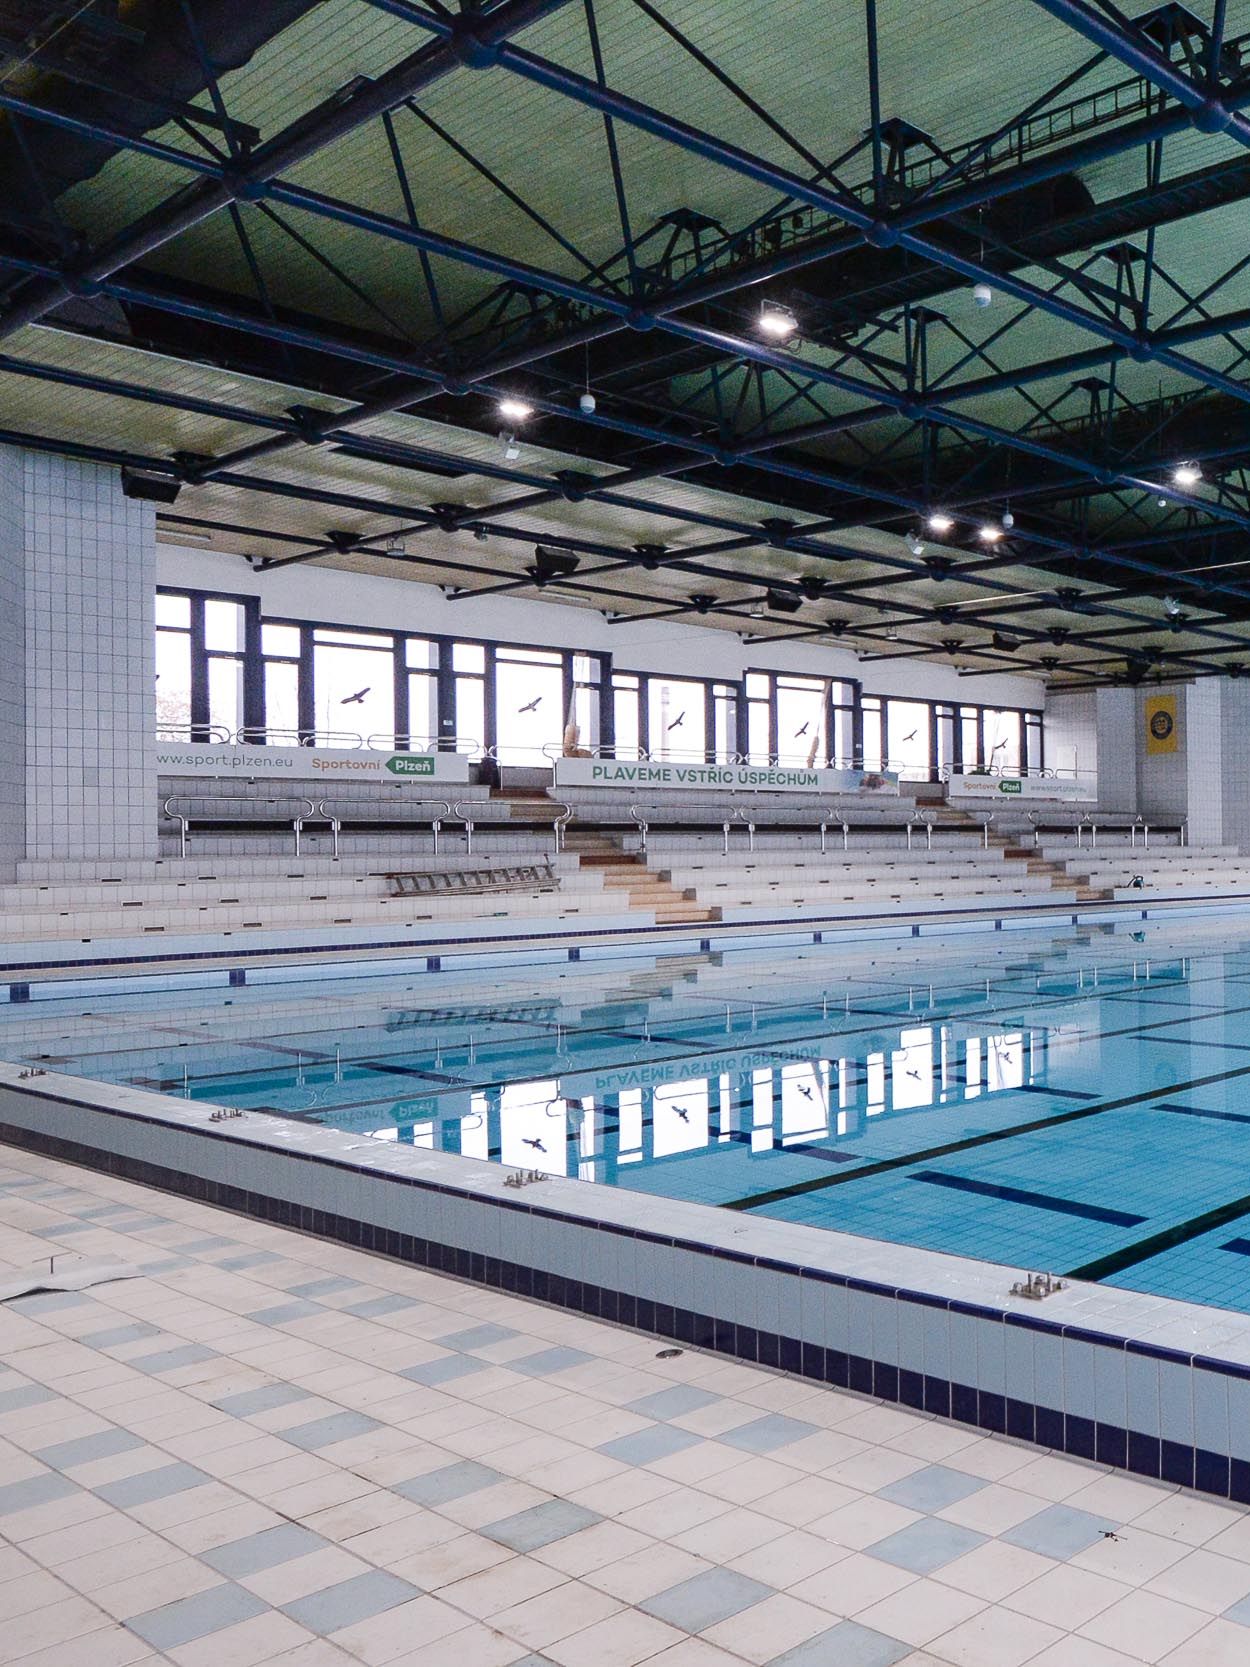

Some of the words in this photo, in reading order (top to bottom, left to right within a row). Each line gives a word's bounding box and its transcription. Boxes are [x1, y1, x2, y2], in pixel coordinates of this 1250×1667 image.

[312, 757, 381, 770] Sportovní
[395, 758, 431, 772] Plzeň
[592, 766, 672, 782] PLAVEME
[676, 767, 733, 784] VSTŘÍC
[738, 768, 819, 786] ÚSPĚCHŮM
